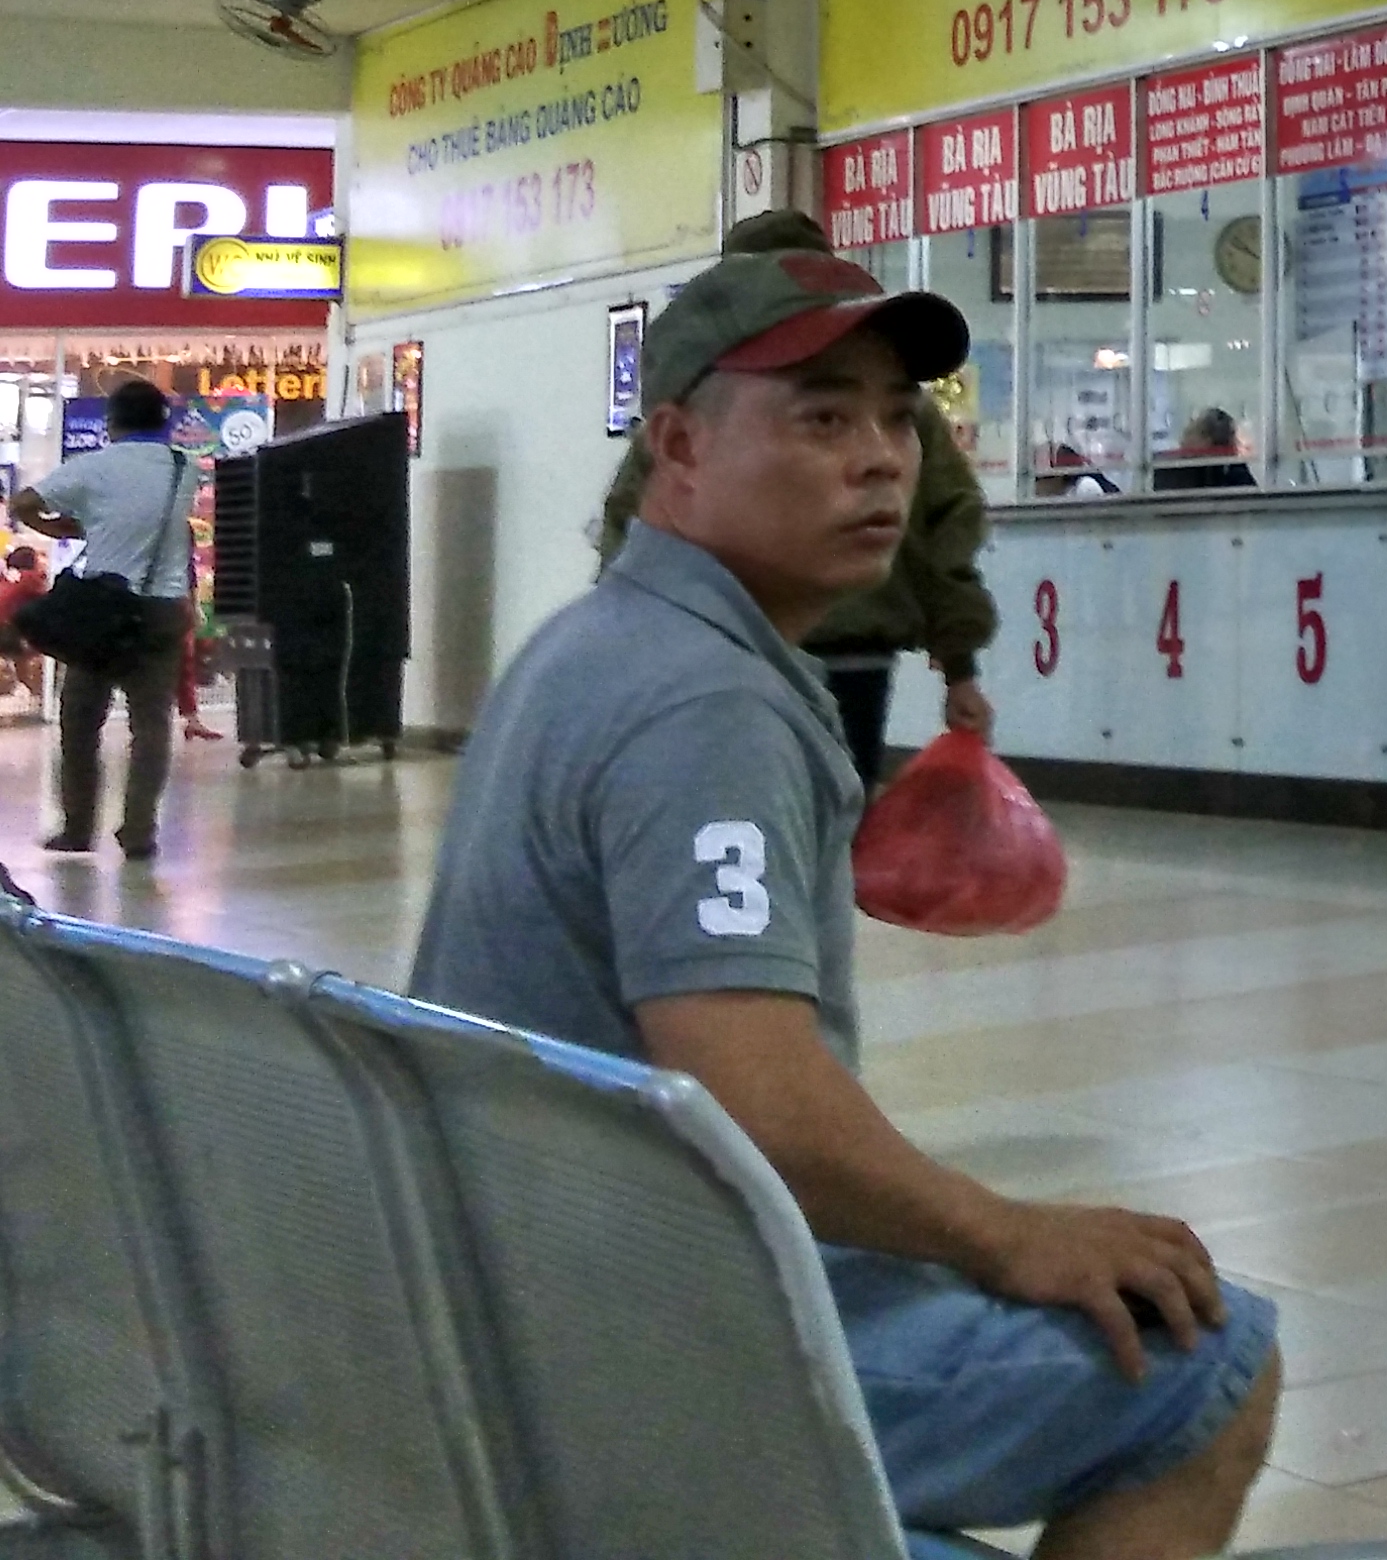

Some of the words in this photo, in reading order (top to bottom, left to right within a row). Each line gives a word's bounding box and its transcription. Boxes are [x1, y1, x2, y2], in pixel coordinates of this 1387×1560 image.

[1033, 579, 1061, 678] 3
[1155, 580, 1185, 680] 4
[1296, 571, 1327, 684] 5
[694, 820, 771, 935] 3
